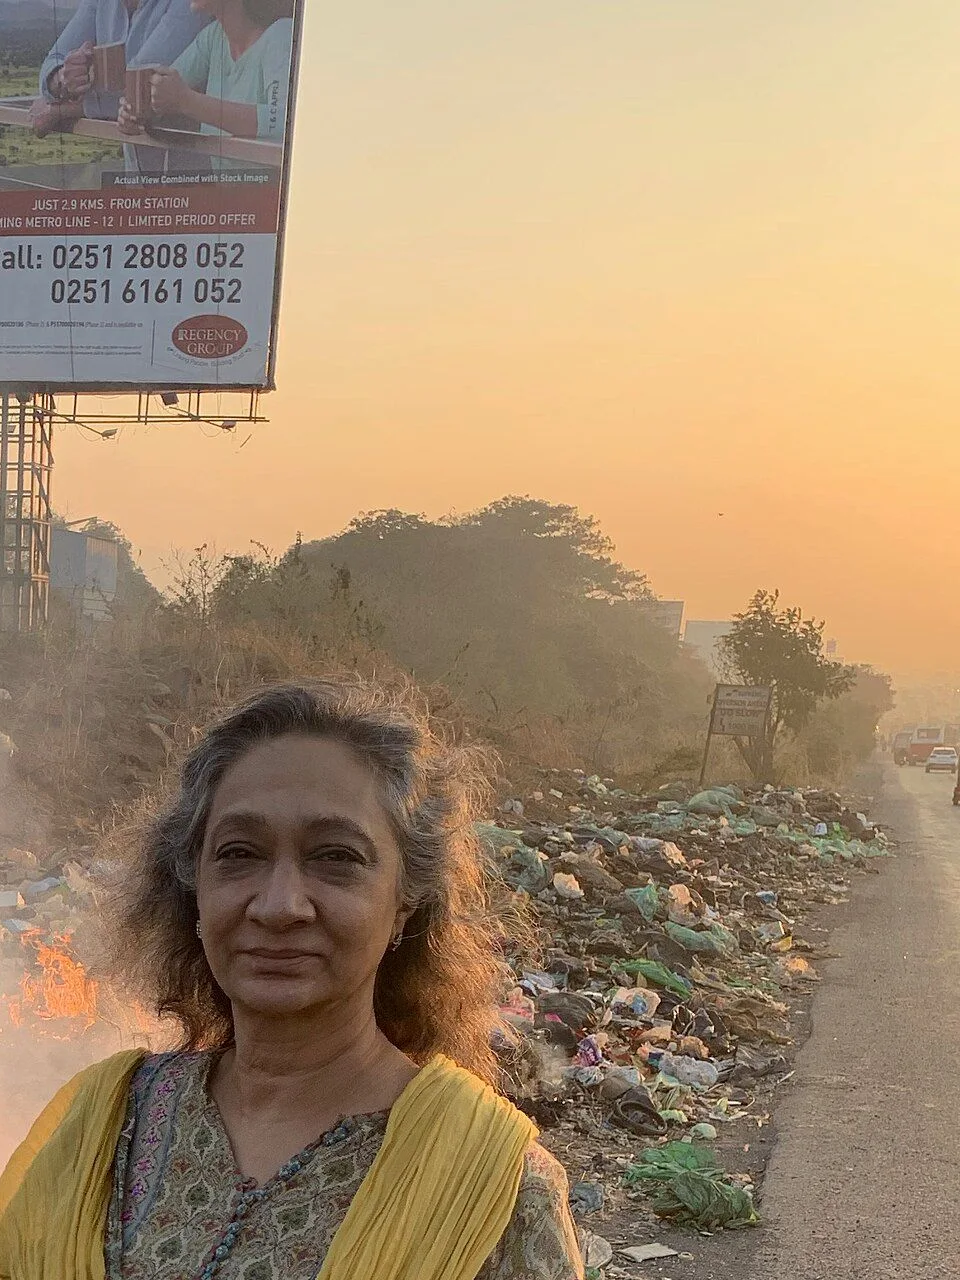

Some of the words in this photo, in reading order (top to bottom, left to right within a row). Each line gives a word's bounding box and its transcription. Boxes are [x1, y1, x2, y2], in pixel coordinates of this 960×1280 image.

[114, 176, 139, 185] Actual
[140, 176, 161, 184] View
[161, 174, 200, 184] Combined
[201, 173, 218, 183] with
[220, 173, 242, 182] Stock
[243, 173, 269, 183] Image
[32, 199, 59, 210] JUST
[62, 199, 77, 210] 2.9
[80, 199, 107, 209] KMS.
[110, 198, 141, 209] FROM
[144, 197, 189, 209] STATION
[26, 216, 62, 227] METRO
[65, 216, 91, 227] LINE
[102, 216, 114, 227] 12
[128, 215, 172, 227] LIMITED
[175, 214, 216, 226] PERIOD
[220, 213, 256, 225] OFFER
[52, 244, 113, 269] 0251
[124, 243, 188, 269] 2808
[196, 242, 245, 268] 052
[51, 278, 110, 304] 0251
[122, 278, 183, 304] 6161
[194, 278, 242, 303] 052
[178, 329, 242, 340] REGENCY
[187, 343, 234, 355] GROUP
